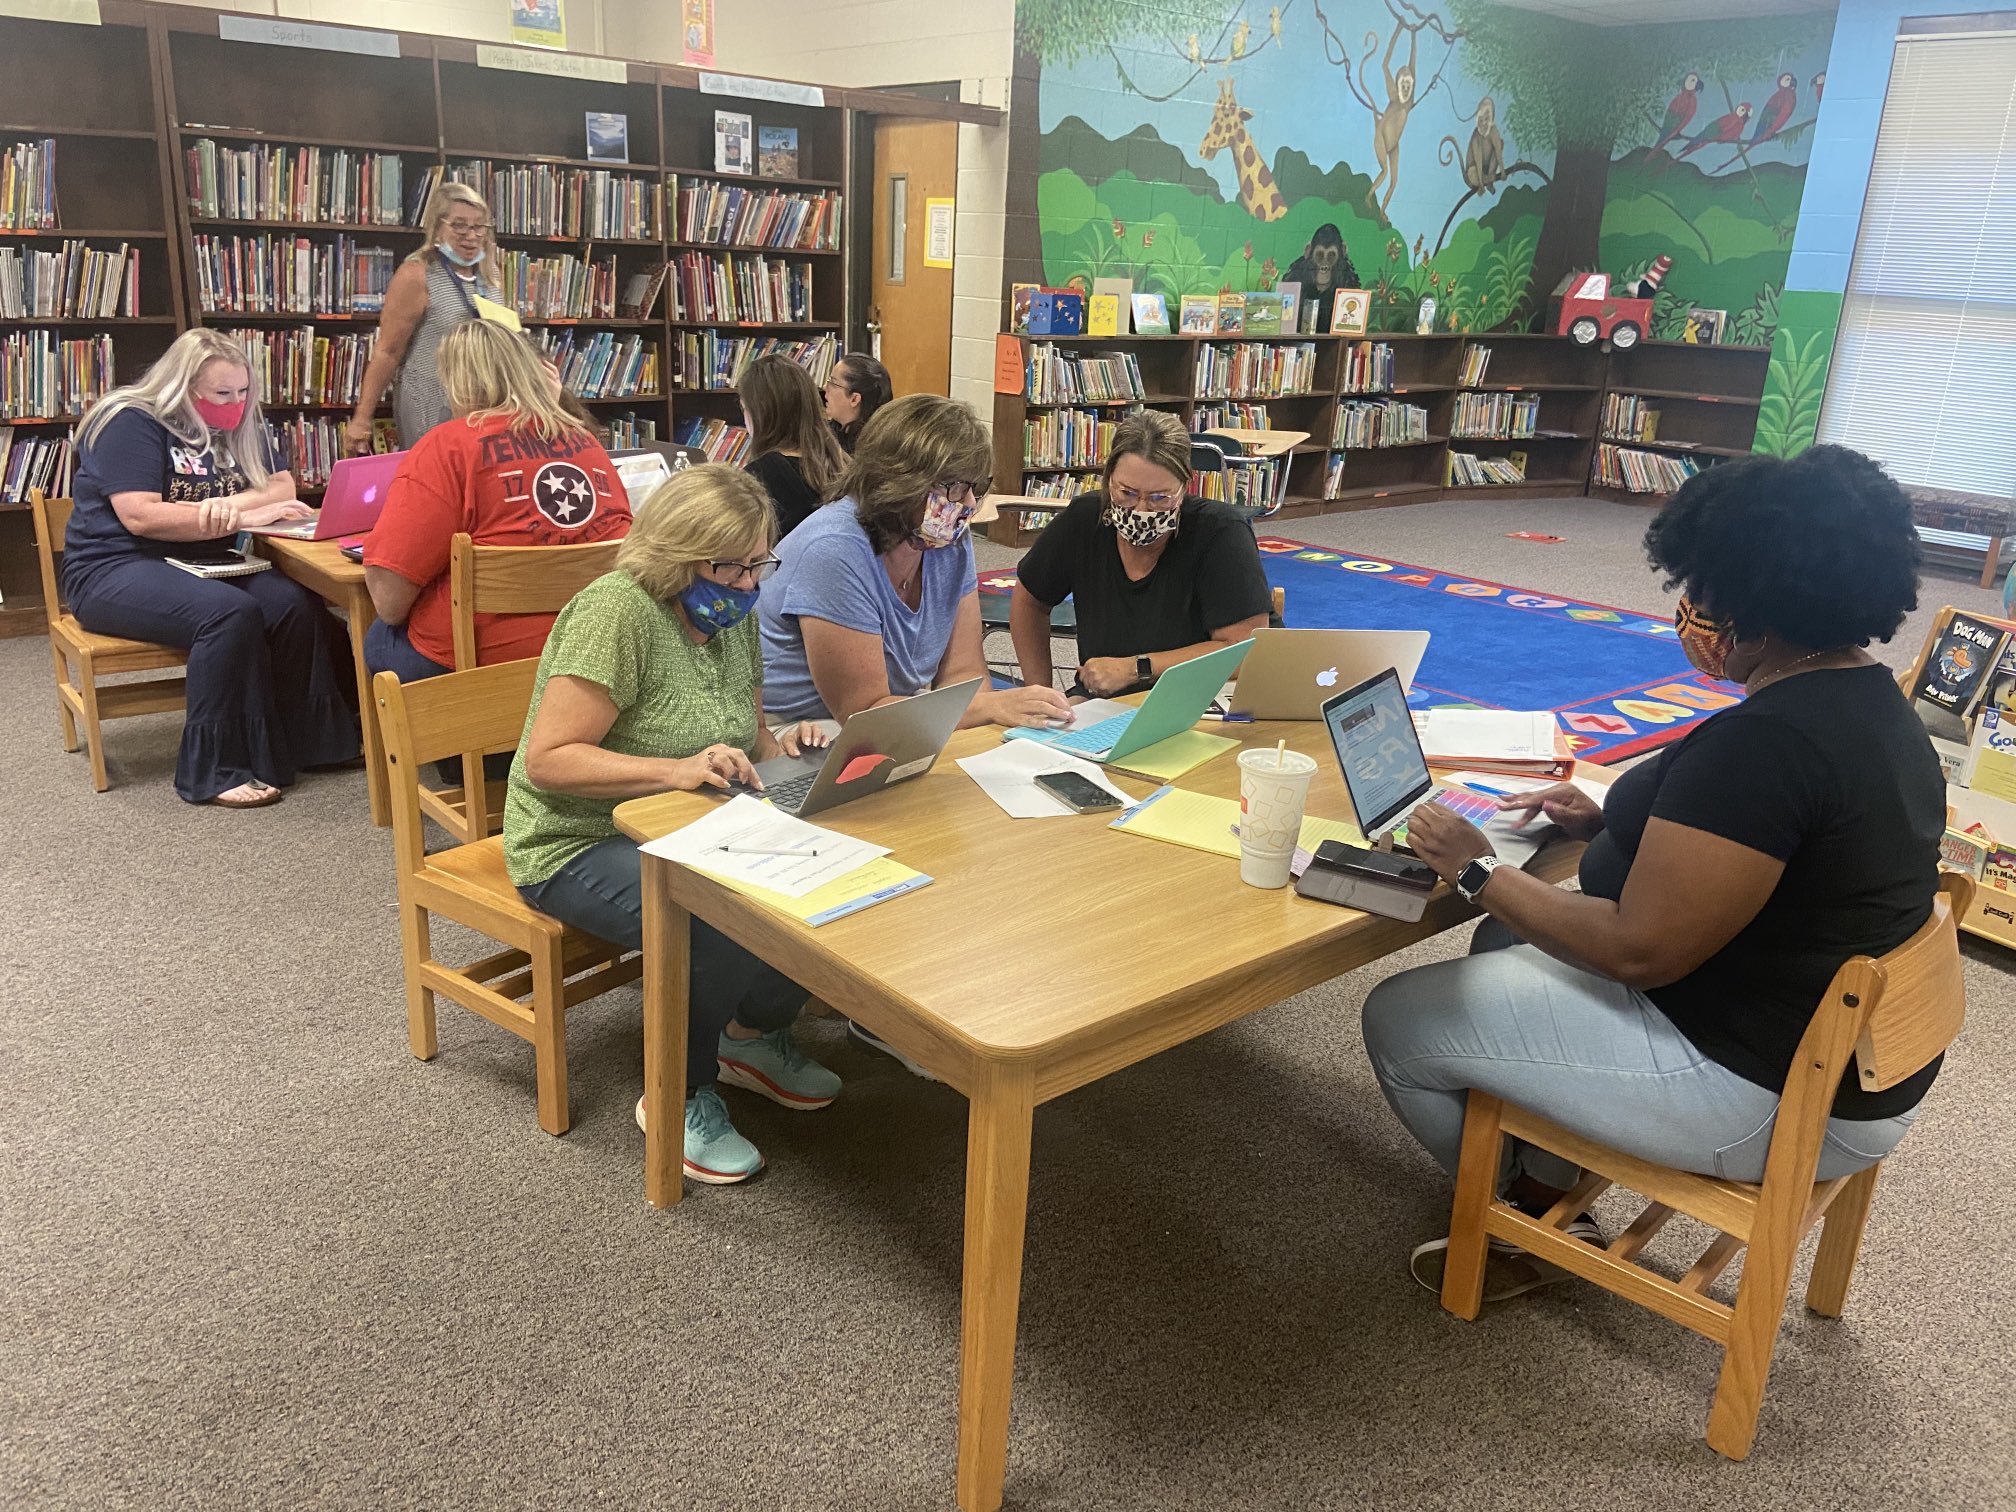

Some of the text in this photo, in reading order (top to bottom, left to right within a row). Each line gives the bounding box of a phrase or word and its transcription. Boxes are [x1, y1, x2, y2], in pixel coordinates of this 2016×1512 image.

[271, 25, 313, 43] Sports
[503, 475, 525, 498] 17
[1953, 621, 1995, 649] DOG MAN
[1944, 756, 1961, 768] Vera
[1947, 848, 1976, 867] TIME
[1985, 867, 1998, 877] It's
